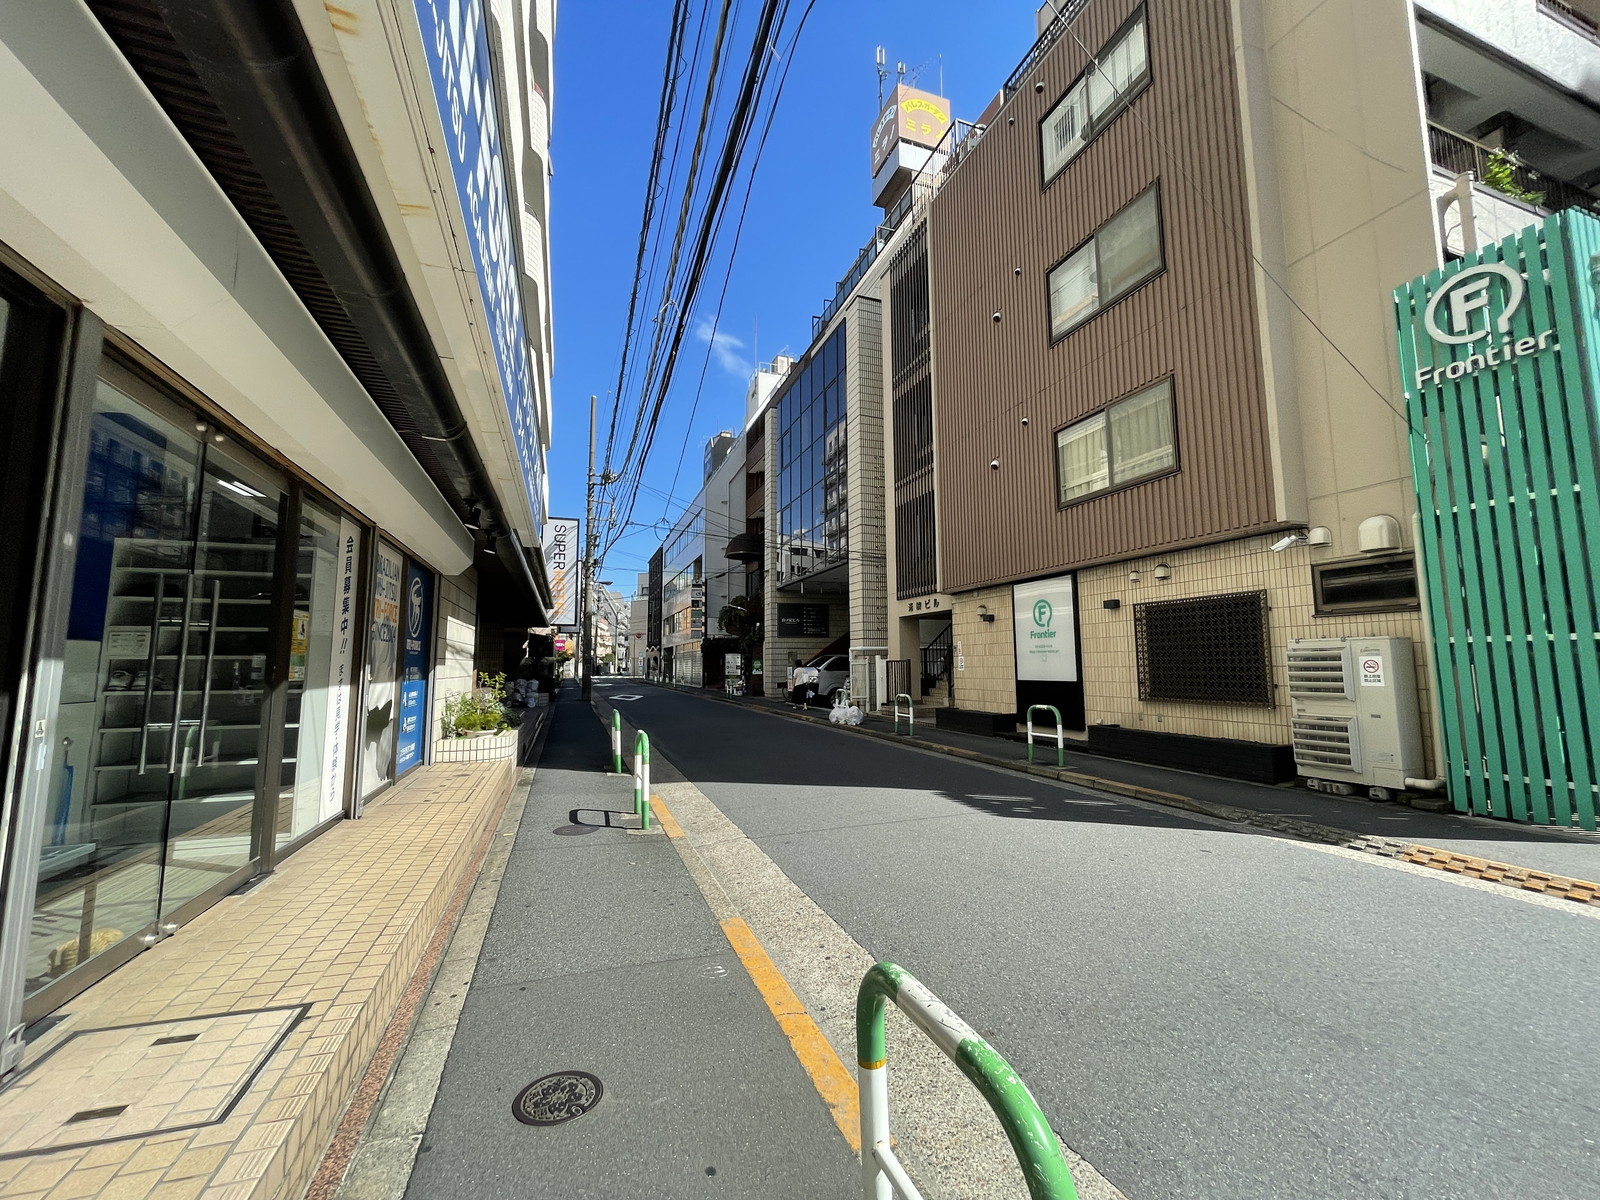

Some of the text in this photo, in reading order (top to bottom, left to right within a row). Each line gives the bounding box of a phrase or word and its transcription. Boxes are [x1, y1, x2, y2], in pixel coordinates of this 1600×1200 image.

[1415, 328, 1555, 389] Frontier
[553, 524, 567, 570] SUPER
[1030, 628, 1057, 639] Frontier
